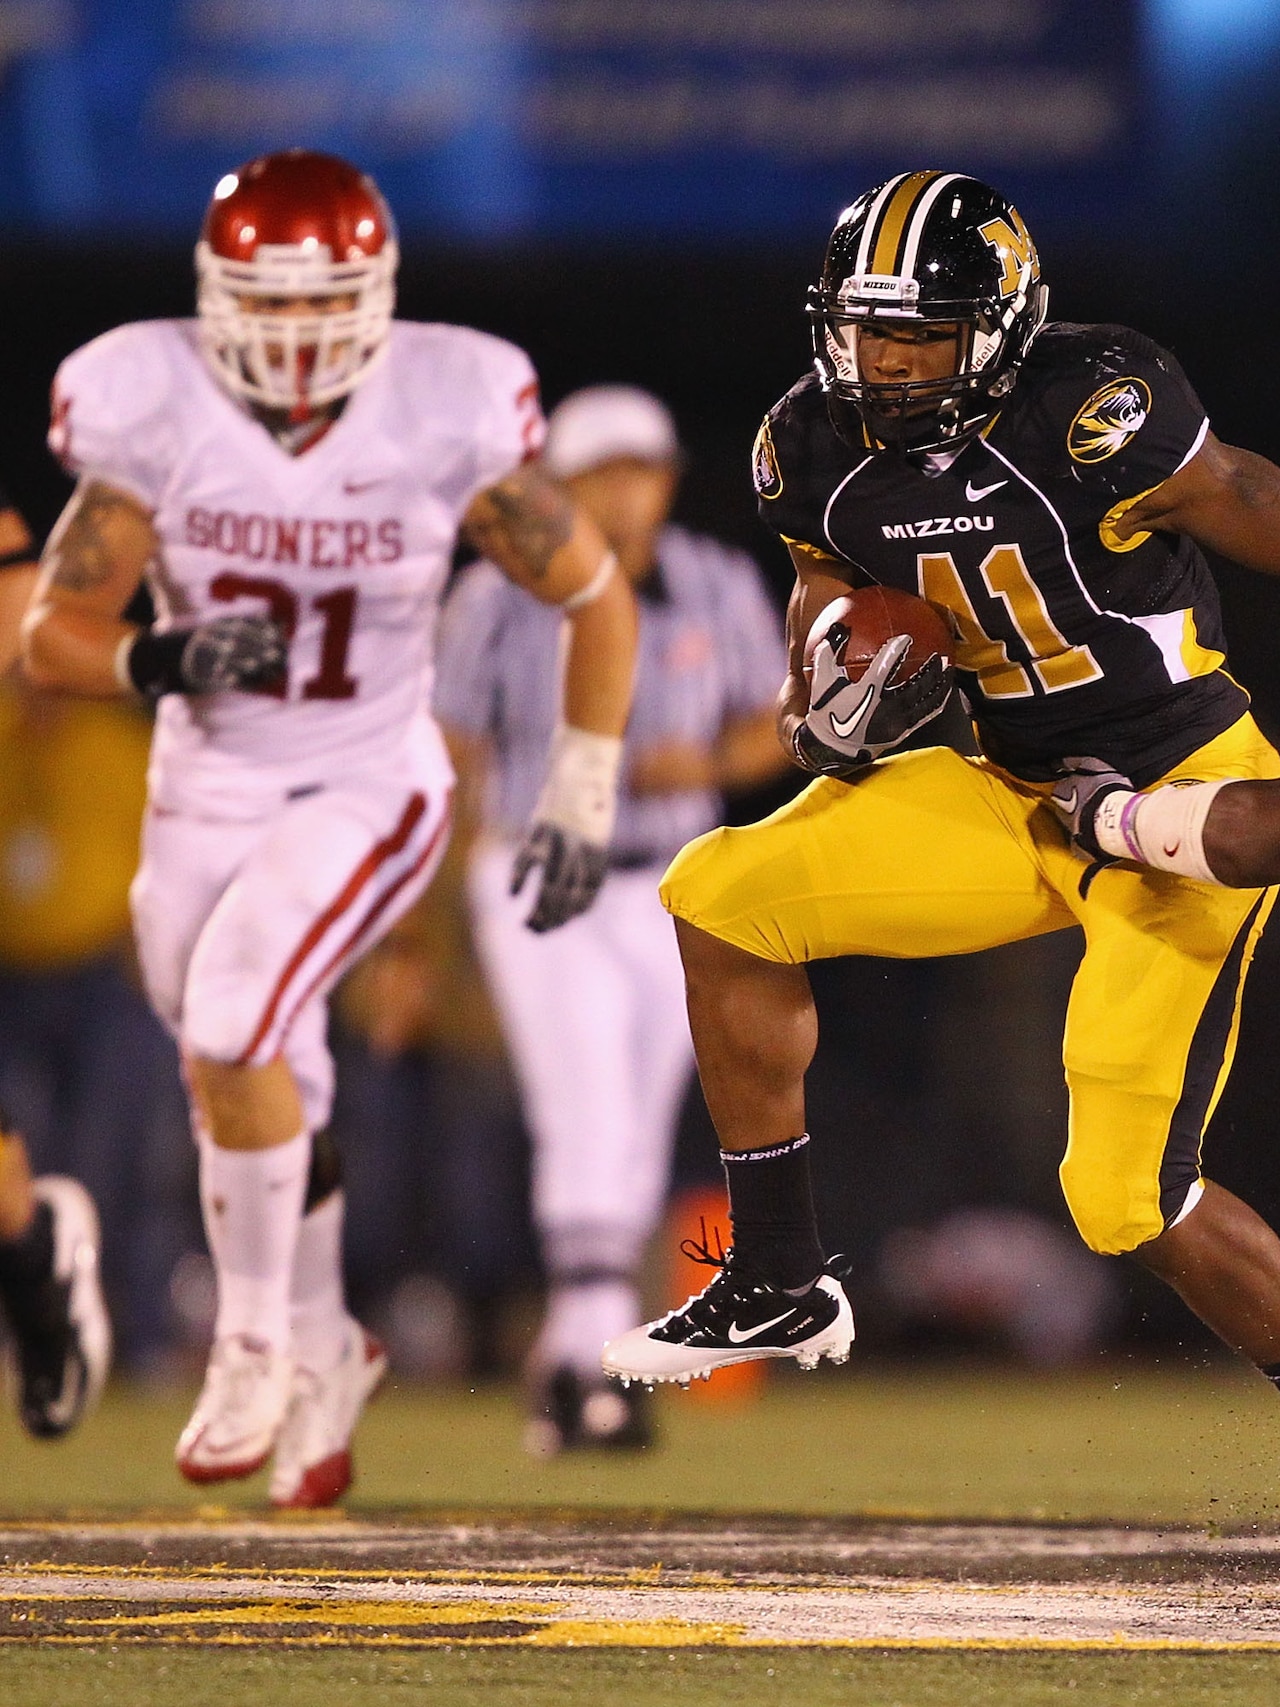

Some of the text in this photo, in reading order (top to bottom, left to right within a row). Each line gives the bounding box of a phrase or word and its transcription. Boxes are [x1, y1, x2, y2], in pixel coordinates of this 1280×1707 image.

[976, 204, 1041, 300] M
[862, 280, 898, 291] MIZZOU
[185, 506, 405, 570] SOONERS
[881, 515, 995, 540] MIZZOU
[916, 542, 1106, 700] 41
